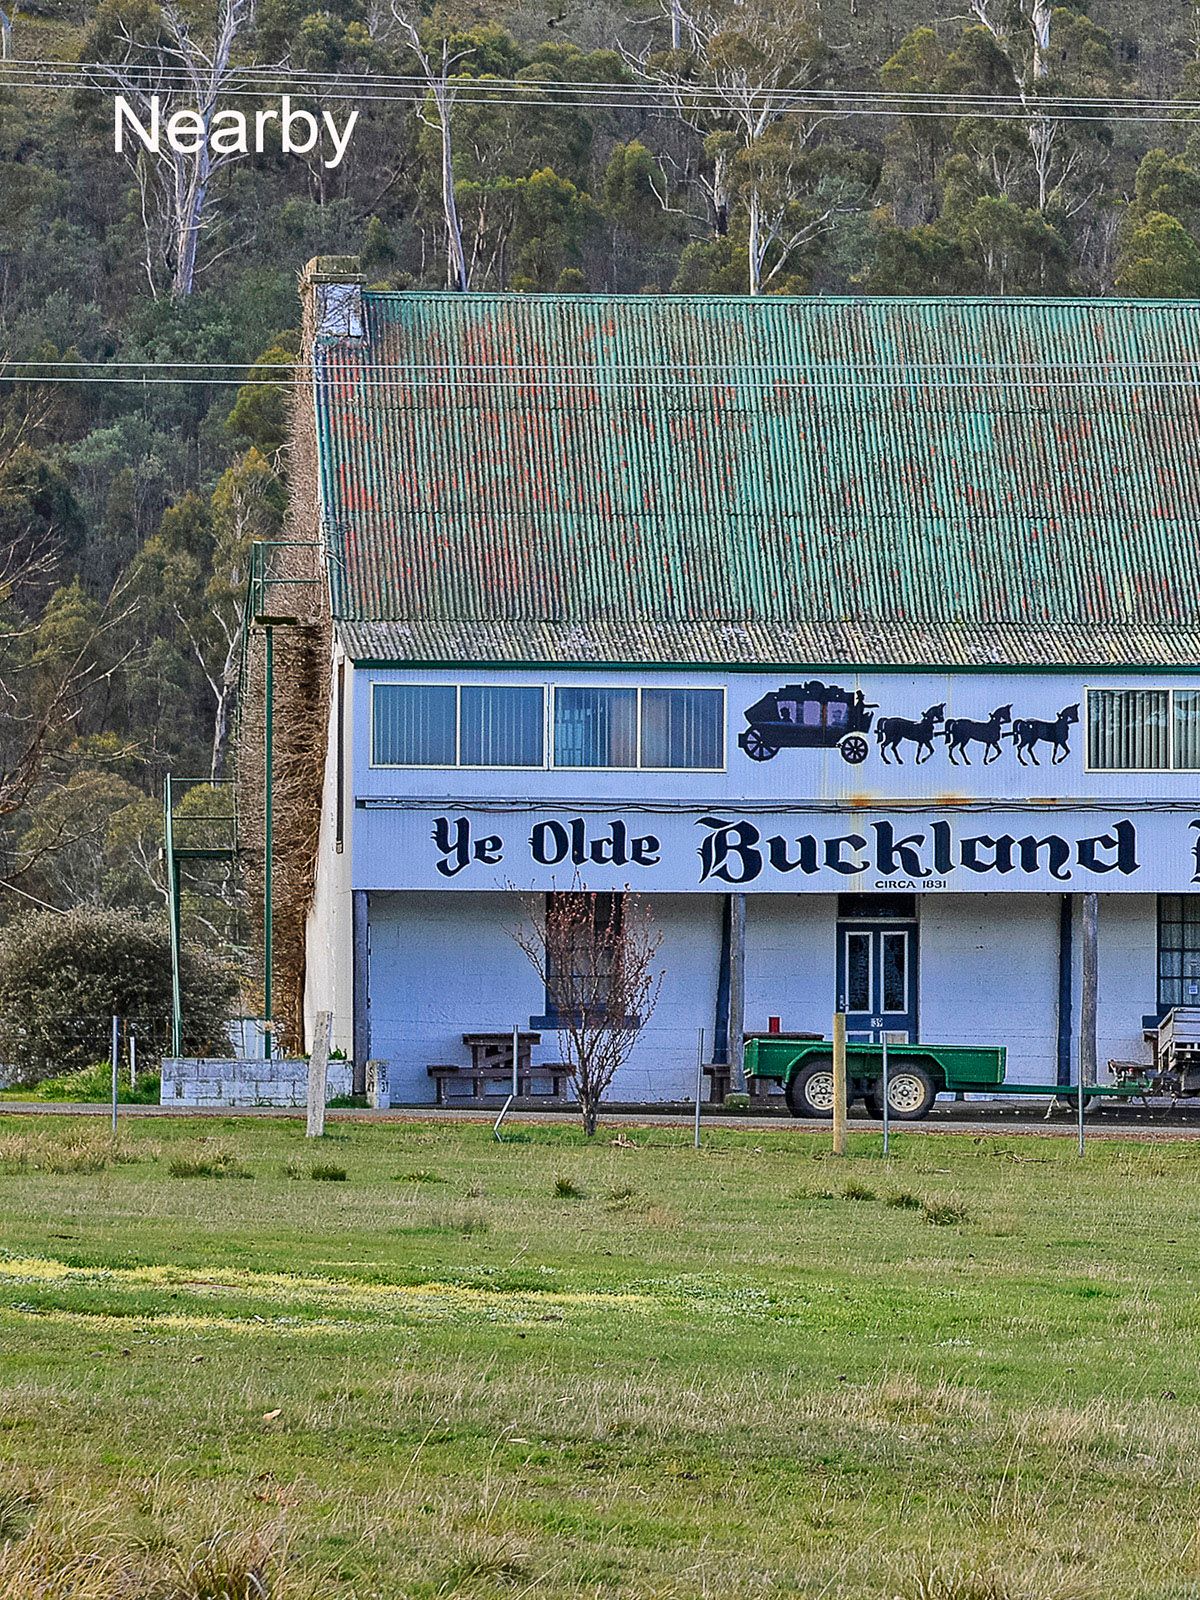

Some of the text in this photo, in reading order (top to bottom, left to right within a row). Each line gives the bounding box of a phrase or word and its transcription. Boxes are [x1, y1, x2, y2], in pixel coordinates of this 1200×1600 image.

[430, 816, 504, 877] Ye
[527, 816, 661, 866] Olde
[693, 816, 1142, 884] Buckland
[874, 880, 947, 889] CIRCA 1831
